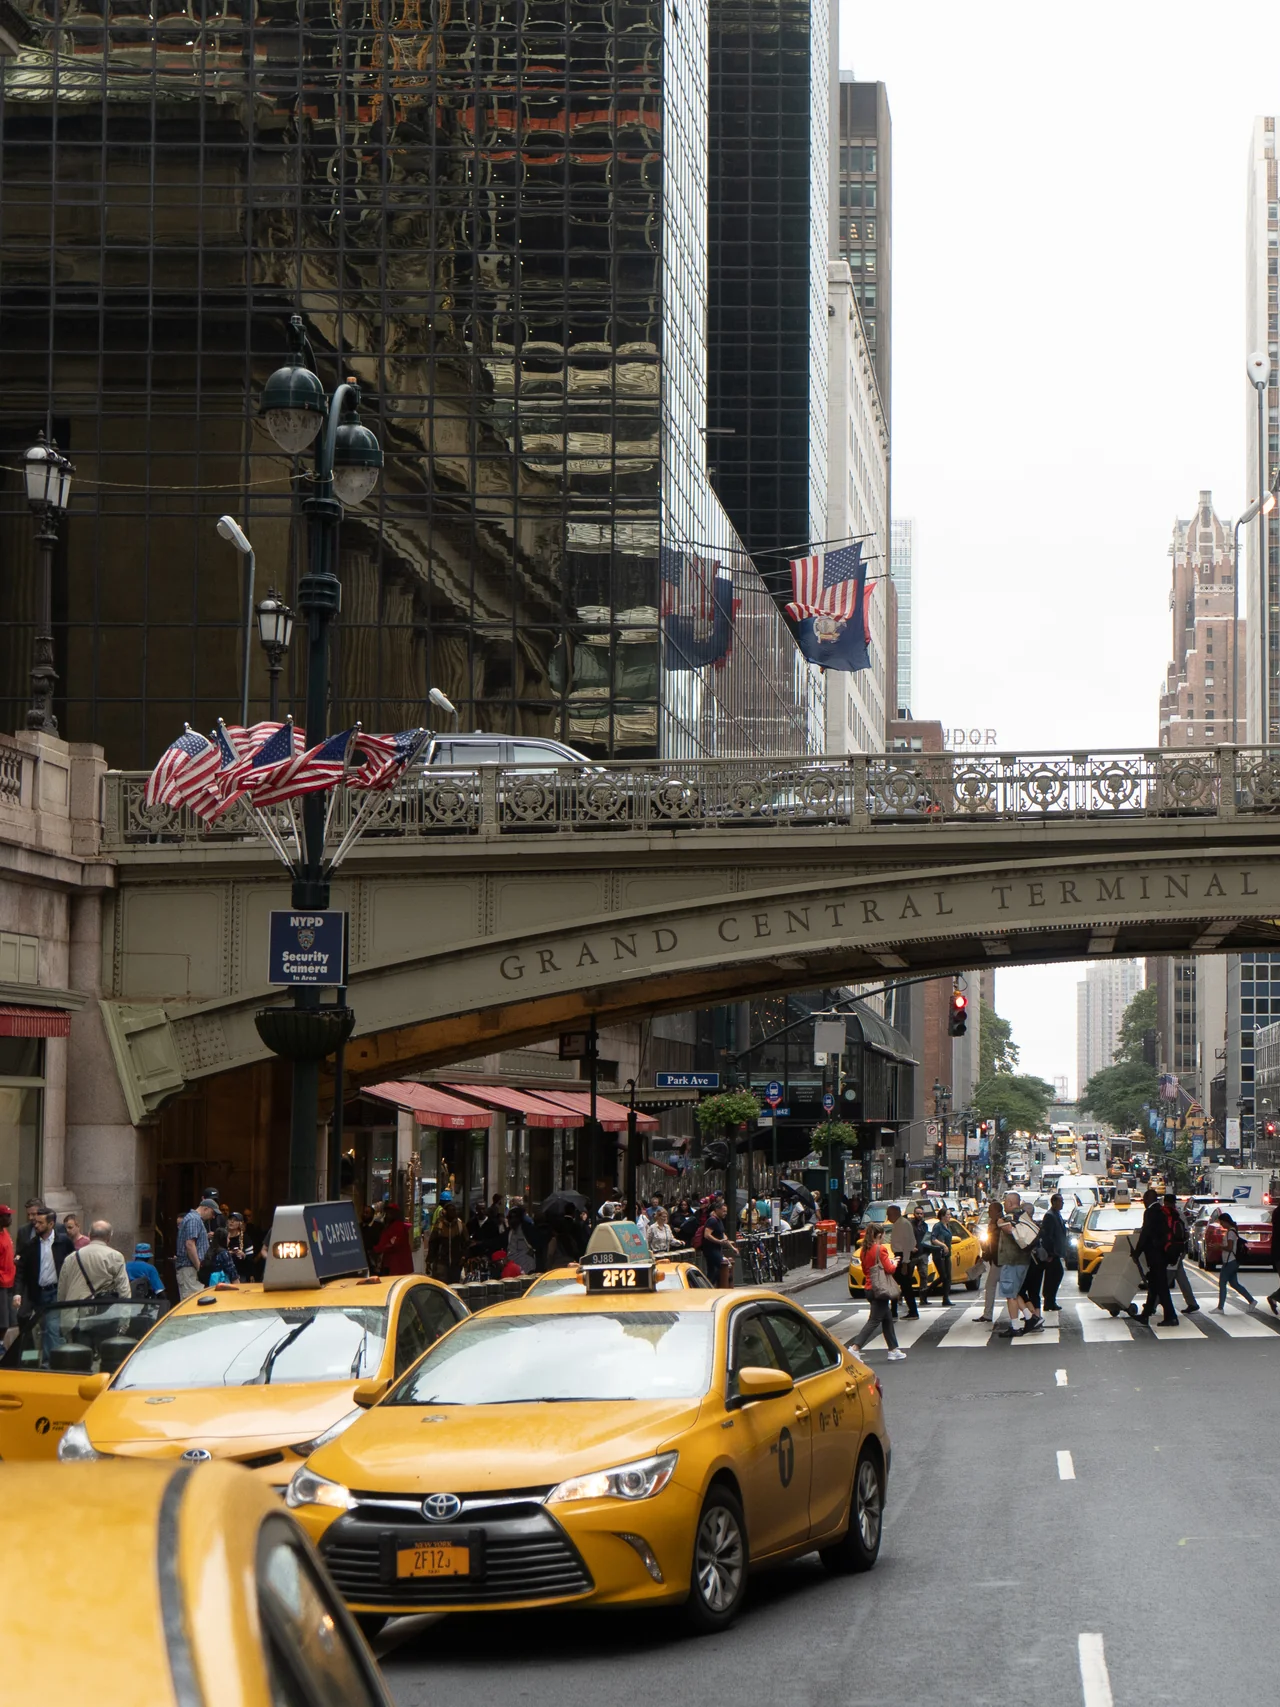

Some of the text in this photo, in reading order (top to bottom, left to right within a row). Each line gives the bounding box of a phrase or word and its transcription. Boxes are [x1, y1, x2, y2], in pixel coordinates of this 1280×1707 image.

[290, 916, 324, 926] NYPD
[500, 872, 1258, 981] GRAND CENTRAL TERMINAL
[282, 951, 329, 964] Security
[283, 962, 328, 973] Camera
[667, 1076, 708, 1085] Park Ave
[326, 1221, 357, 1244] CAPSULE
[278, 1242, 300, 1258] 1F51
[593, 1254, 614, 1264] 9J88
[603, 1269, 636, 1287] 2F12
[414, 1550, 451, 1570] 2F12J
